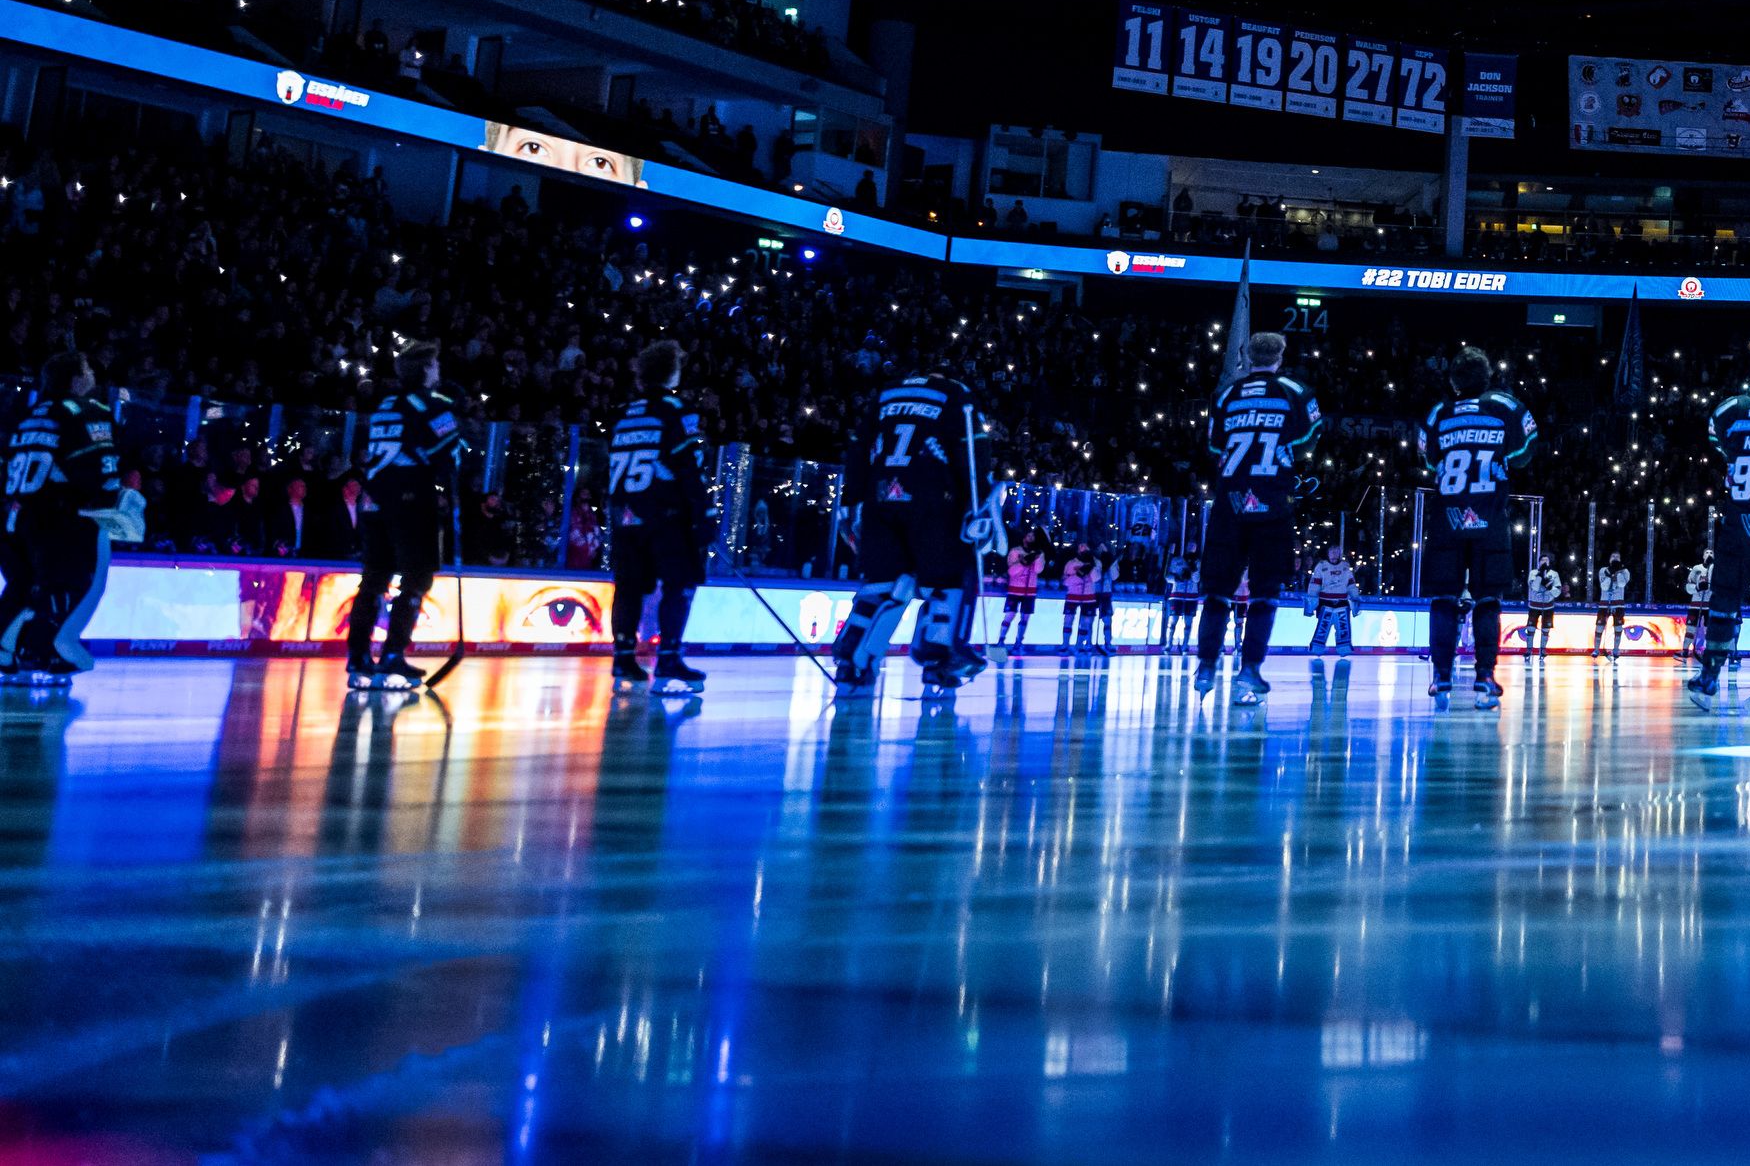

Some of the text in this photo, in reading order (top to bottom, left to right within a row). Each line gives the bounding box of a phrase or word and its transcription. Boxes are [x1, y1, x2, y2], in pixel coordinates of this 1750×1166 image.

[1125, 16, 1164, 71] 11
[1180, 24, 1226, 79] 14
[1237, 34, 1283, 87] 19
[1288, 40, 1339, 95] 20
[1345, 49, 1395, 103] 27
[1400, 57, 1447, 113] 72
[1466, 82, 1513, 94] JACKSON
[1479, 71, 1502, 82] DON
[1361, 268, 1507, 291] #22 TOBI EDER
[1283, 306, 1329, 334] 214
[1224, 409, 1285, 433] SCHÄFER
[1439, 428, 1506, 451] SCHNEIDER
[884, 423, 917, 467] 1
[1222, 431, 1281, 477] 71
[608, 449, 661, 495] 75
[1440, 449, 1497, 496] 81
[130, 641, 177, 652] PENNY
[206, 641, 251, 652] PENNY
[282, 641, 323, 652] PENNY
